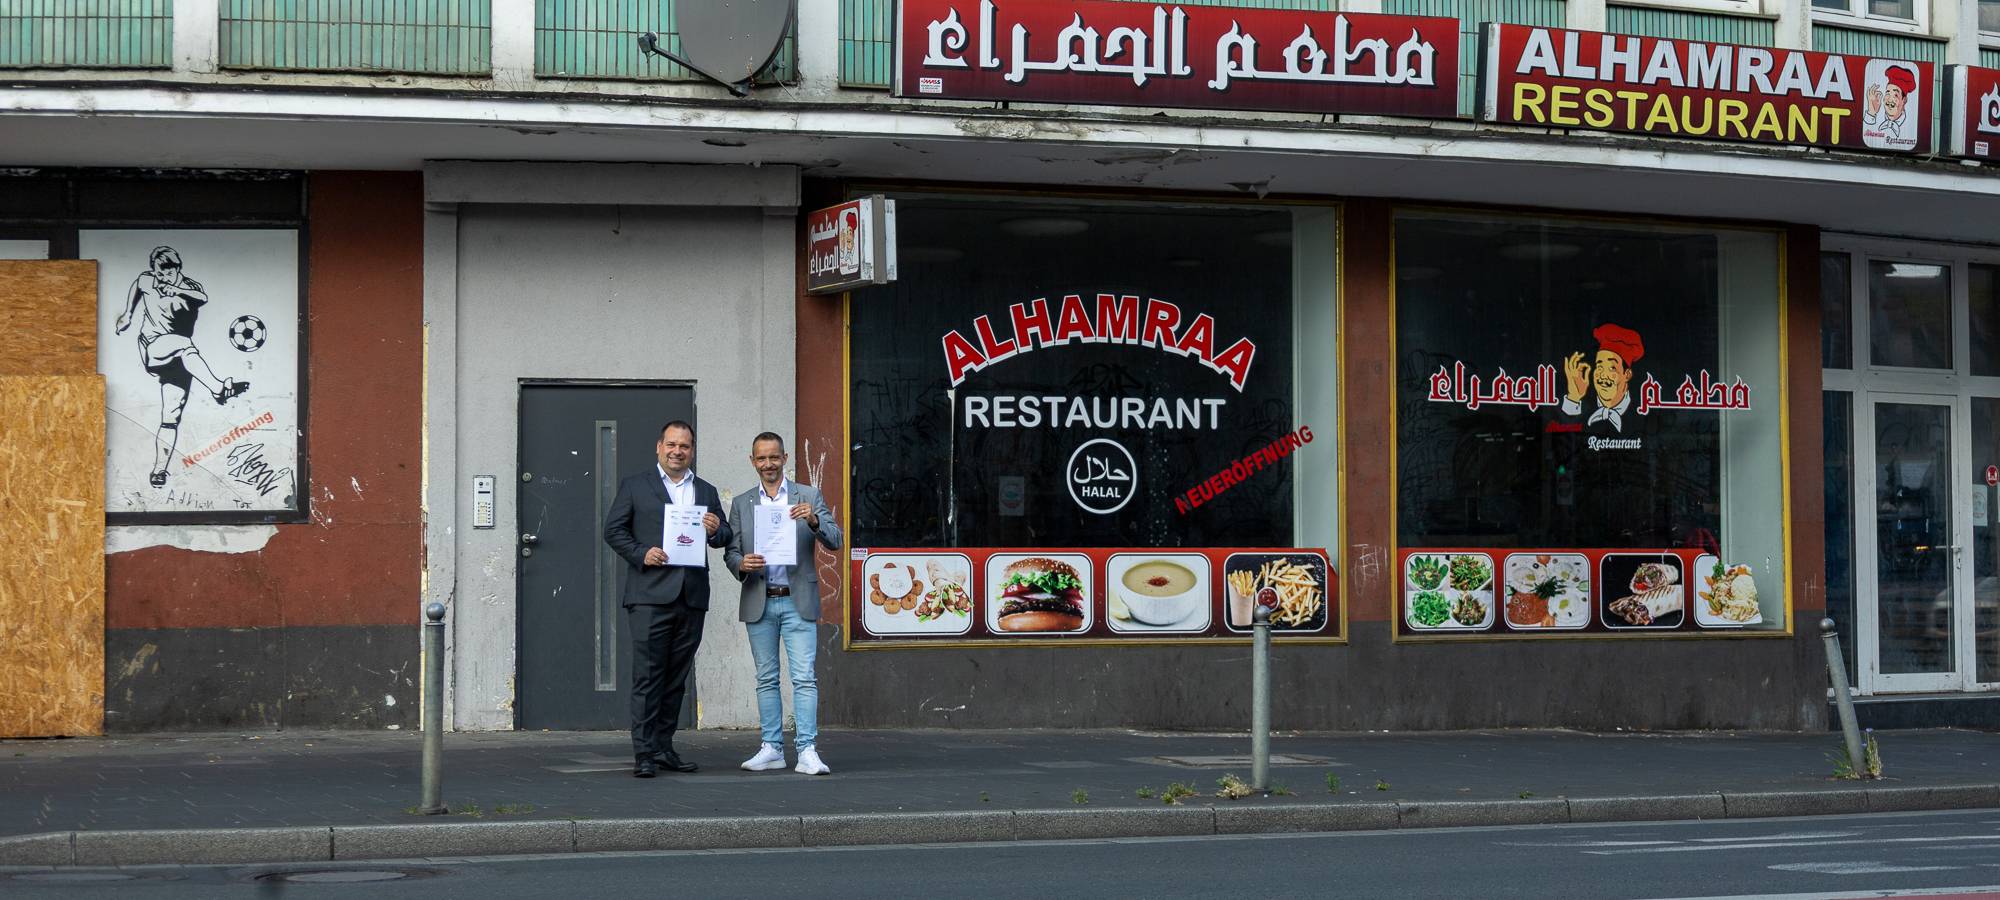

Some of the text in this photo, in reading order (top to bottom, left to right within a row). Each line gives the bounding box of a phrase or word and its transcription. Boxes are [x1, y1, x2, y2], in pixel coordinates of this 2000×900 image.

[1207, 14, 1436, 90] مطعم
[1516, 28, 1854, 101] ALHAMRAA
[1512, 82, 1851, 145] RESTAURANT
[942, 294, 1257, 393] ALHAMRAA
[965, 396, 1226, 430] RESTAURANT
[1637, 369, 1752, 415] مطعم
[182, 411, 274, 468] Neueröffnung
[1588, 436, 1641, 451] Restaurant
[1074, 455, 1129, 484] حلال
[1081, 486, 1121, 498] HALAL
[1174, 425, 1314, 515] NEUERÖFFNUNG
